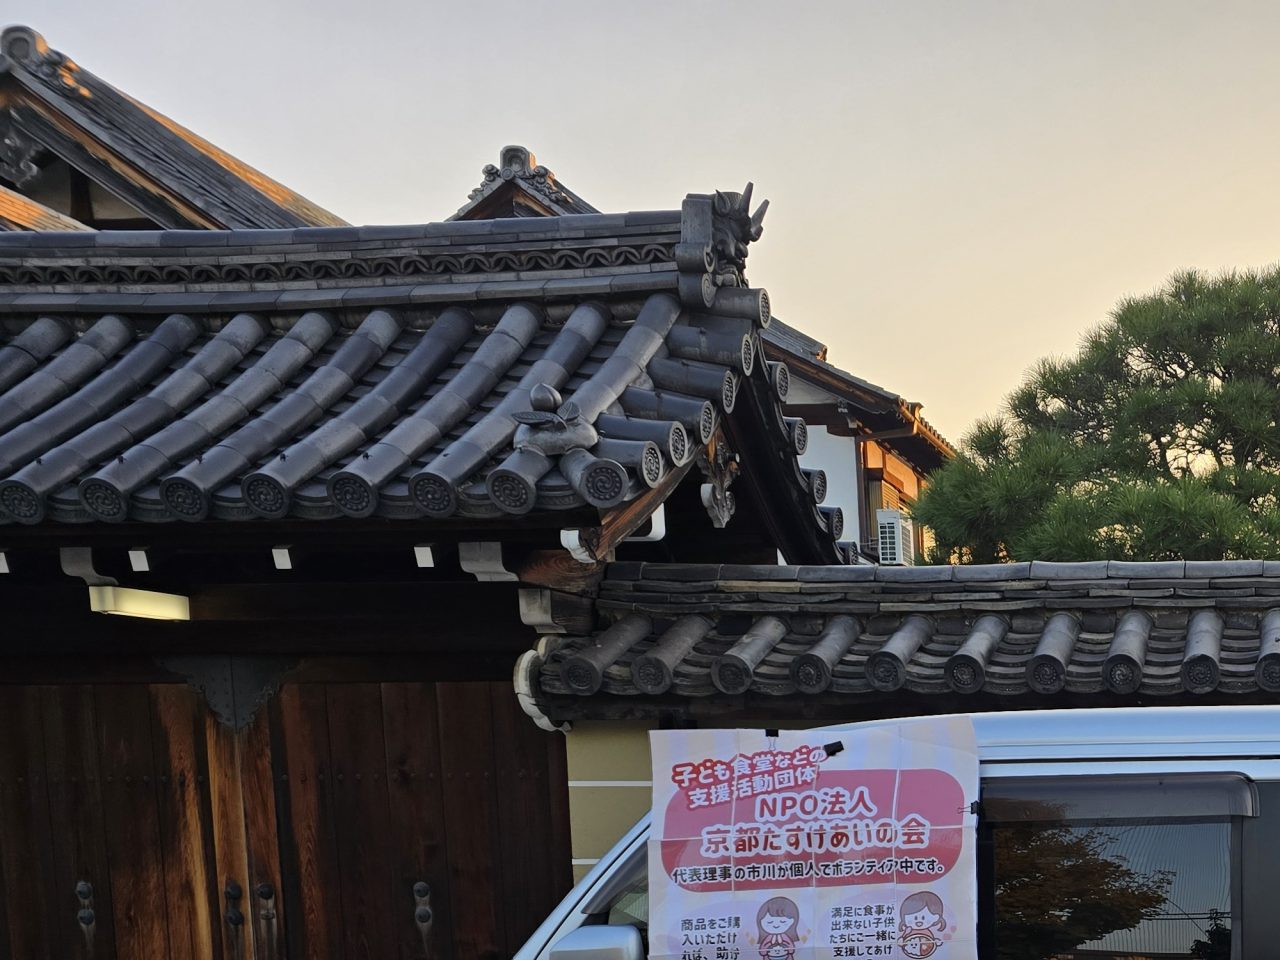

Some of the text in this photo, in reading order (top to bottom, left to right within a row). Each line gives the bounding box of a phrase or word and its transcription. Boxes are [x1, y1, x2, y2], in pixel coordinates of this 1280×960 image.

[674, 747, 828, 788] 子ども食堂などの
[687, 764, 817, 808] 支援活動団体
[759, 789, 874, 818] NPO法人
[705, 816, 927, 853] 京都たすけあいの会
[672, 857, 944, 883] 代表理事の市川が個人でボランティア中です。
[831, 904, 895, 918] 満足に食事が
[831, 916, 895, 931] 出来ない子供
[829, 930, 896, 944] たちにご一緒に
